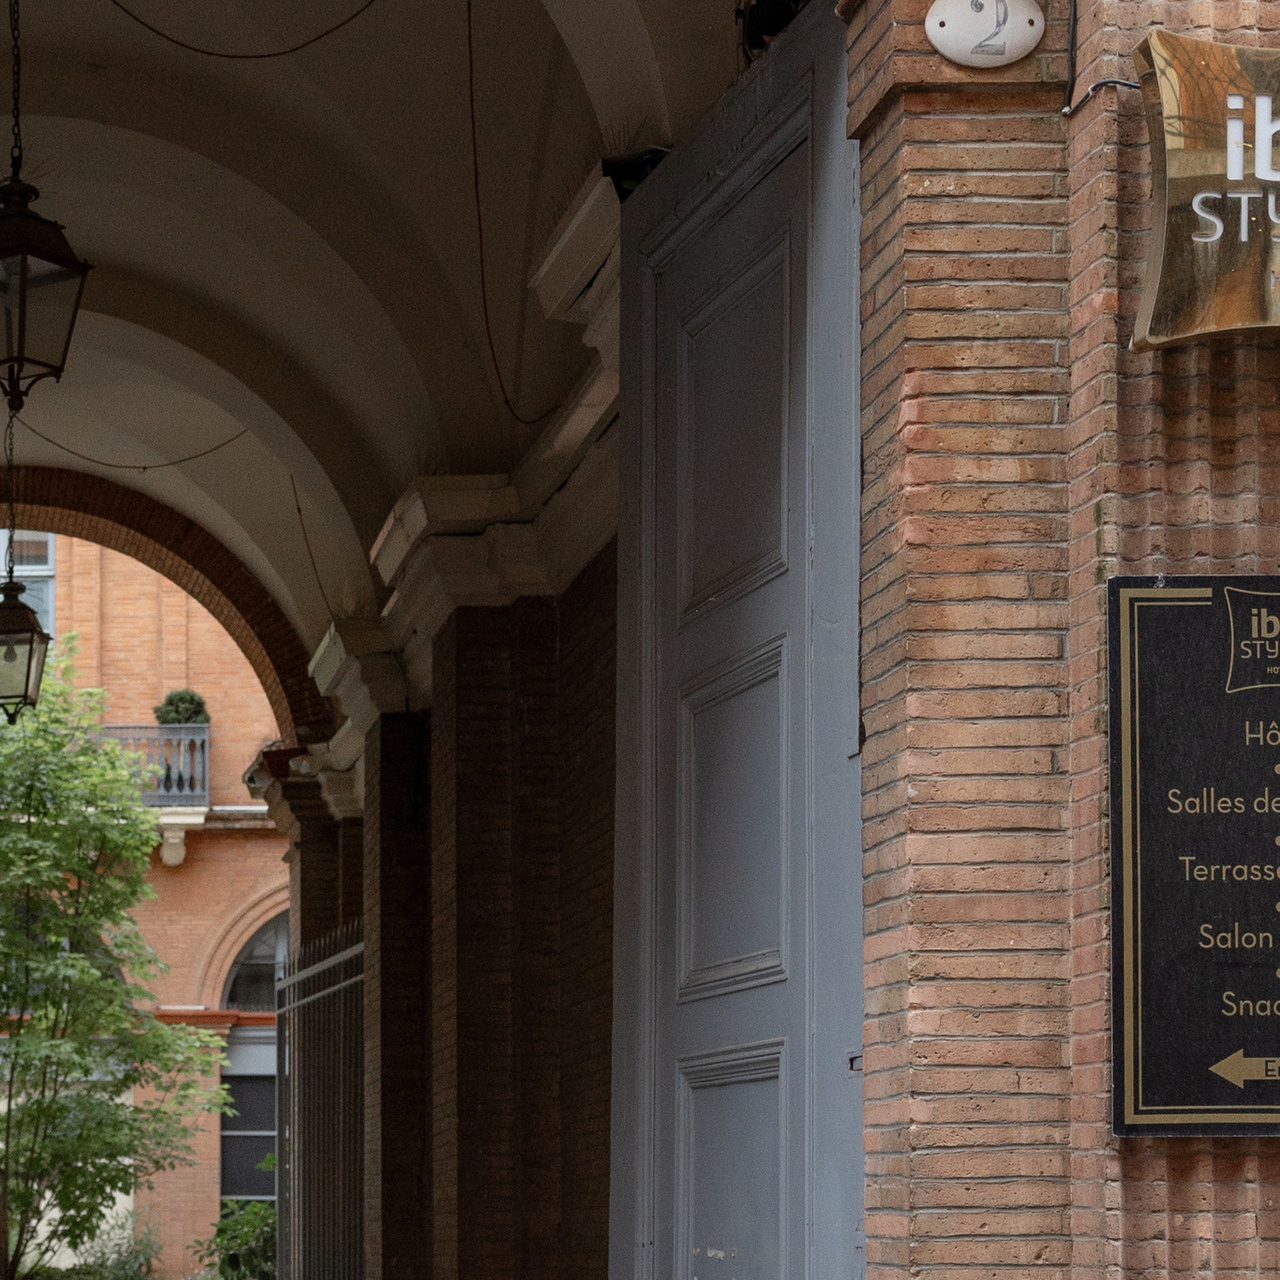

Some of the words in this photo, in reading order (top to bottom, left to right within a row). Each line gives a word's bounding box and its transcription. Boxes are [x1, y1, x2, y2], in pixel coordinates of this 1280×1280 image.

[1266, 666, 1280, 674] HO
[1167, 786, 1245, 813] Salles
[1178, 856, 1280, 881] Terrass
[1198, 922, 1273, 949] Salon
